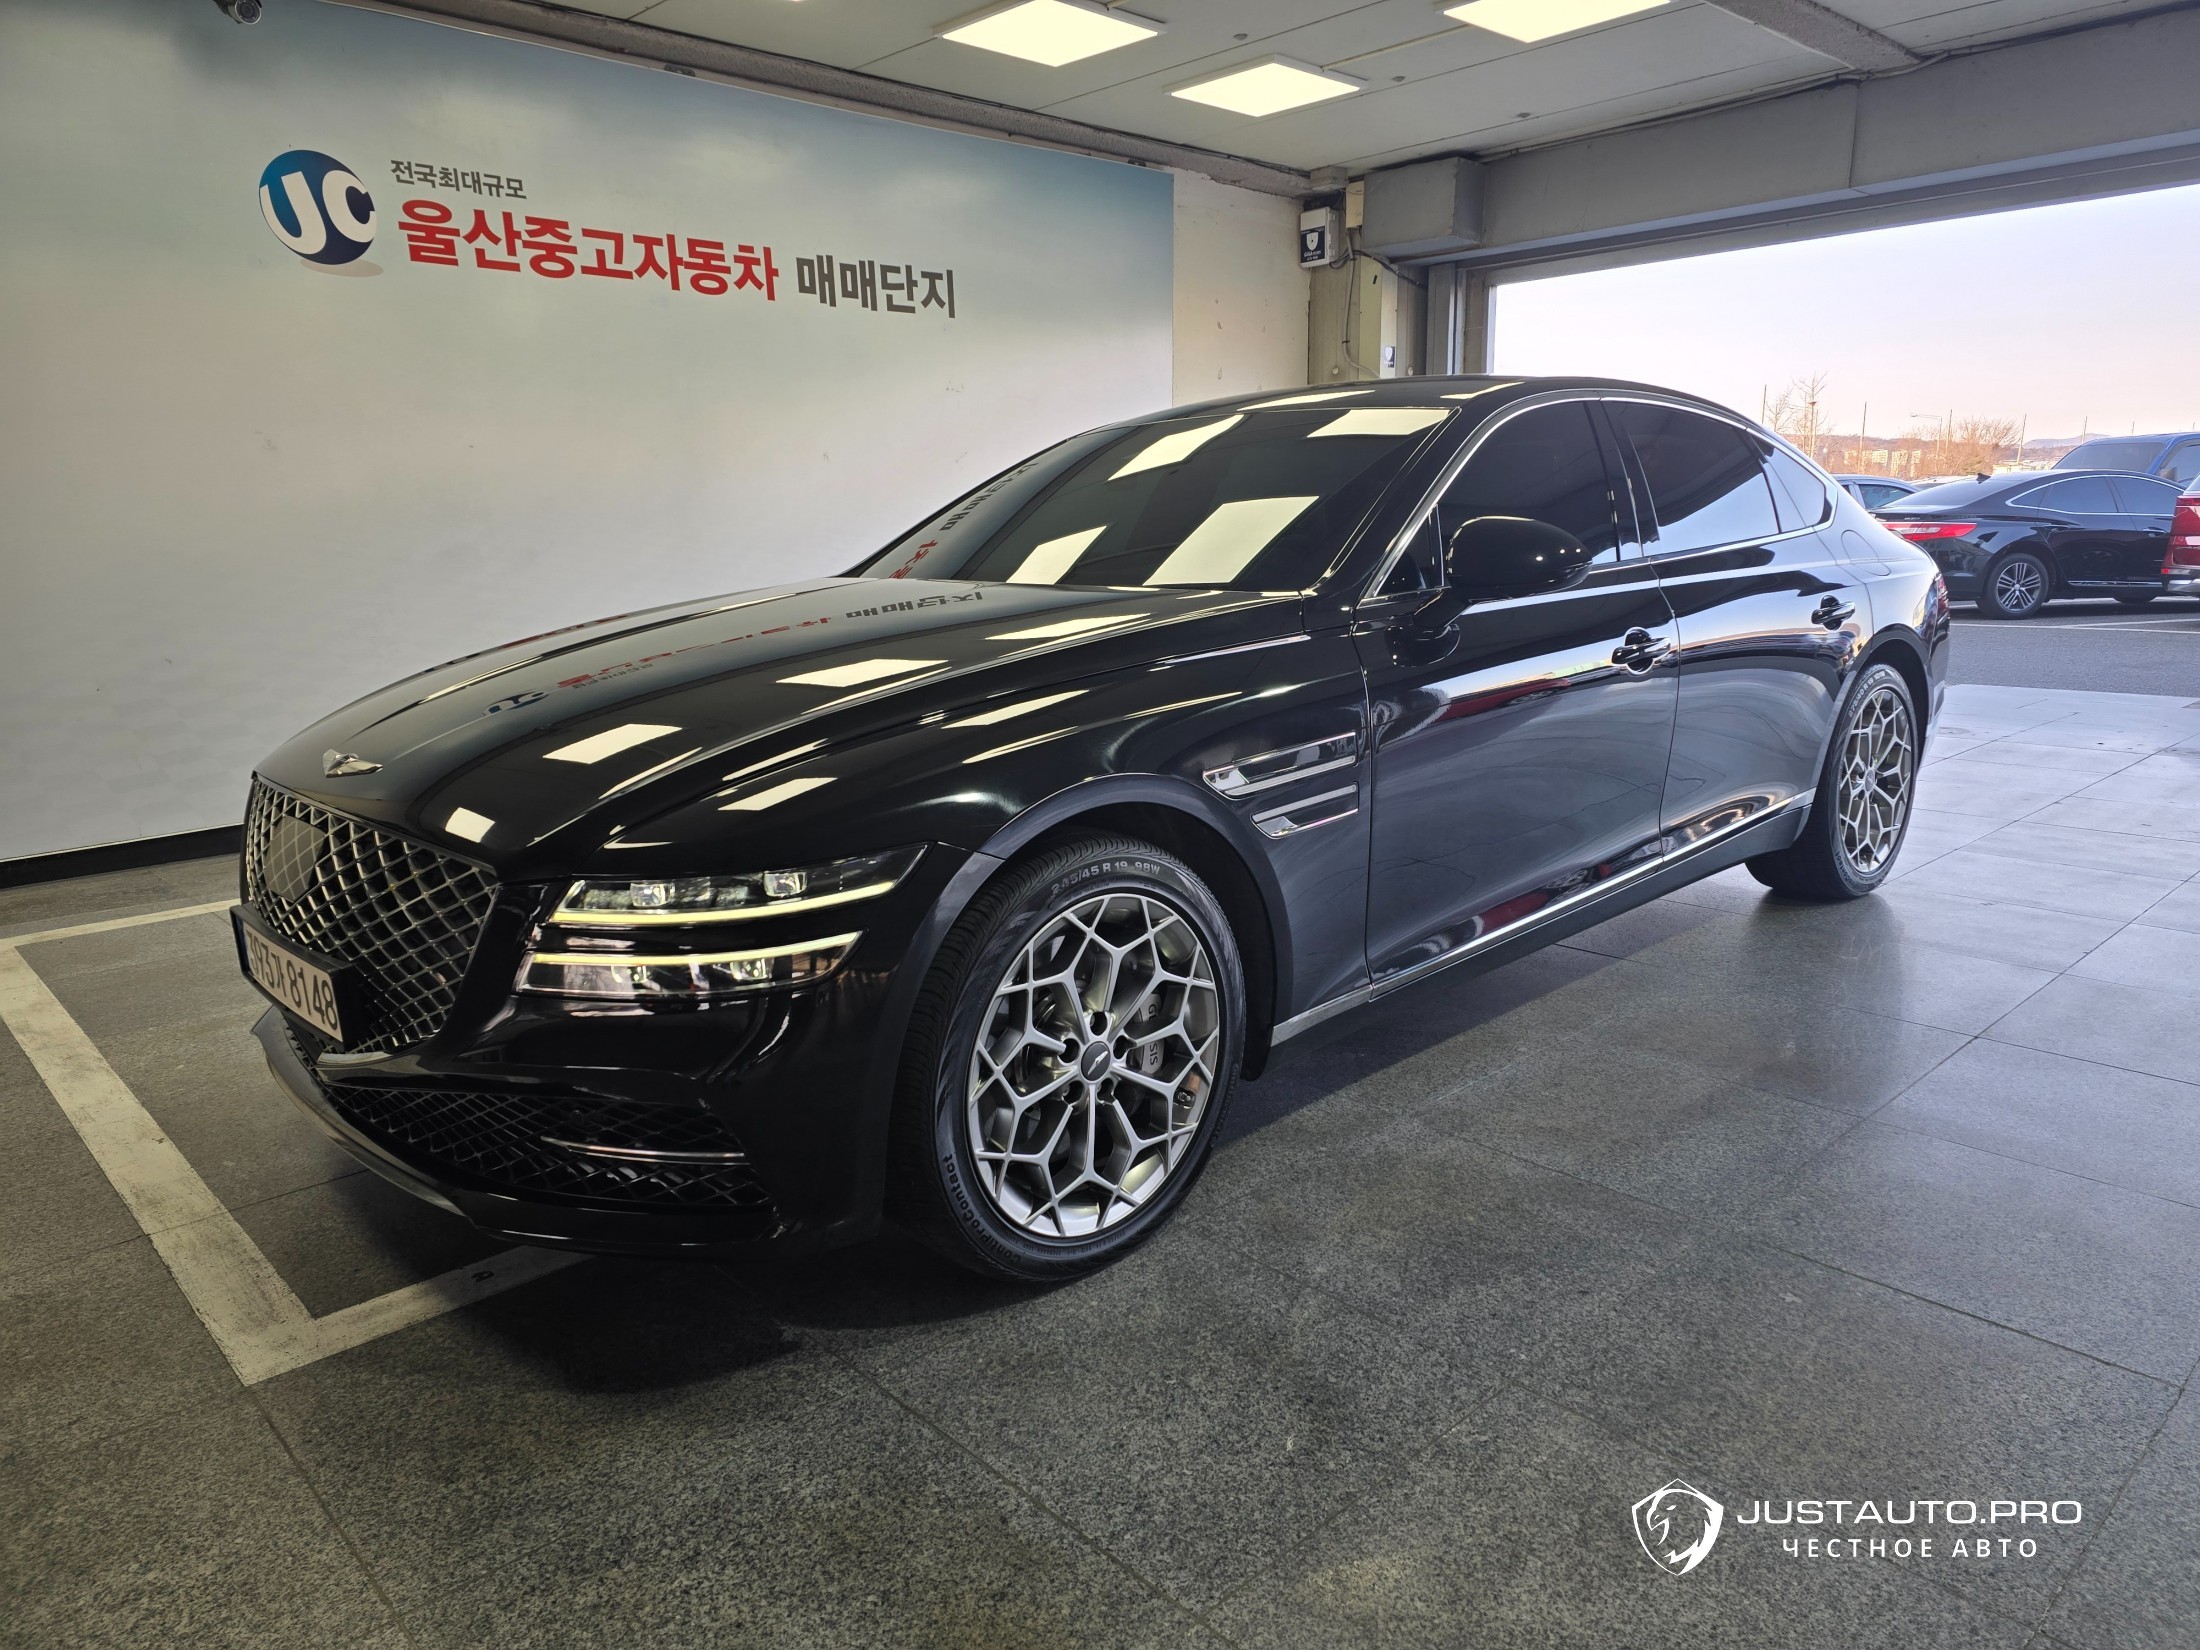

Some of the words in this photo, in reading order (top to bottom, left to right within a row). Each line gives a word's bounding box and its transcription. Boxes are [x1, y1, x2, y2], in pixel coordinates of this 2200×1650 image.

[259, 169, 377, 256] UC
[390, 159, 527, 200] 전국최대규모
[398, 199, 779, 301] 울산중고자동차
[795, 254, 957, 319] 매매단지
[1102, 862, 1112, 873] R
[1114, 860, 1128, 872] 19
[1134, 861, 1160, 875] 98W
[286, 959, 338, 1031] 8148
